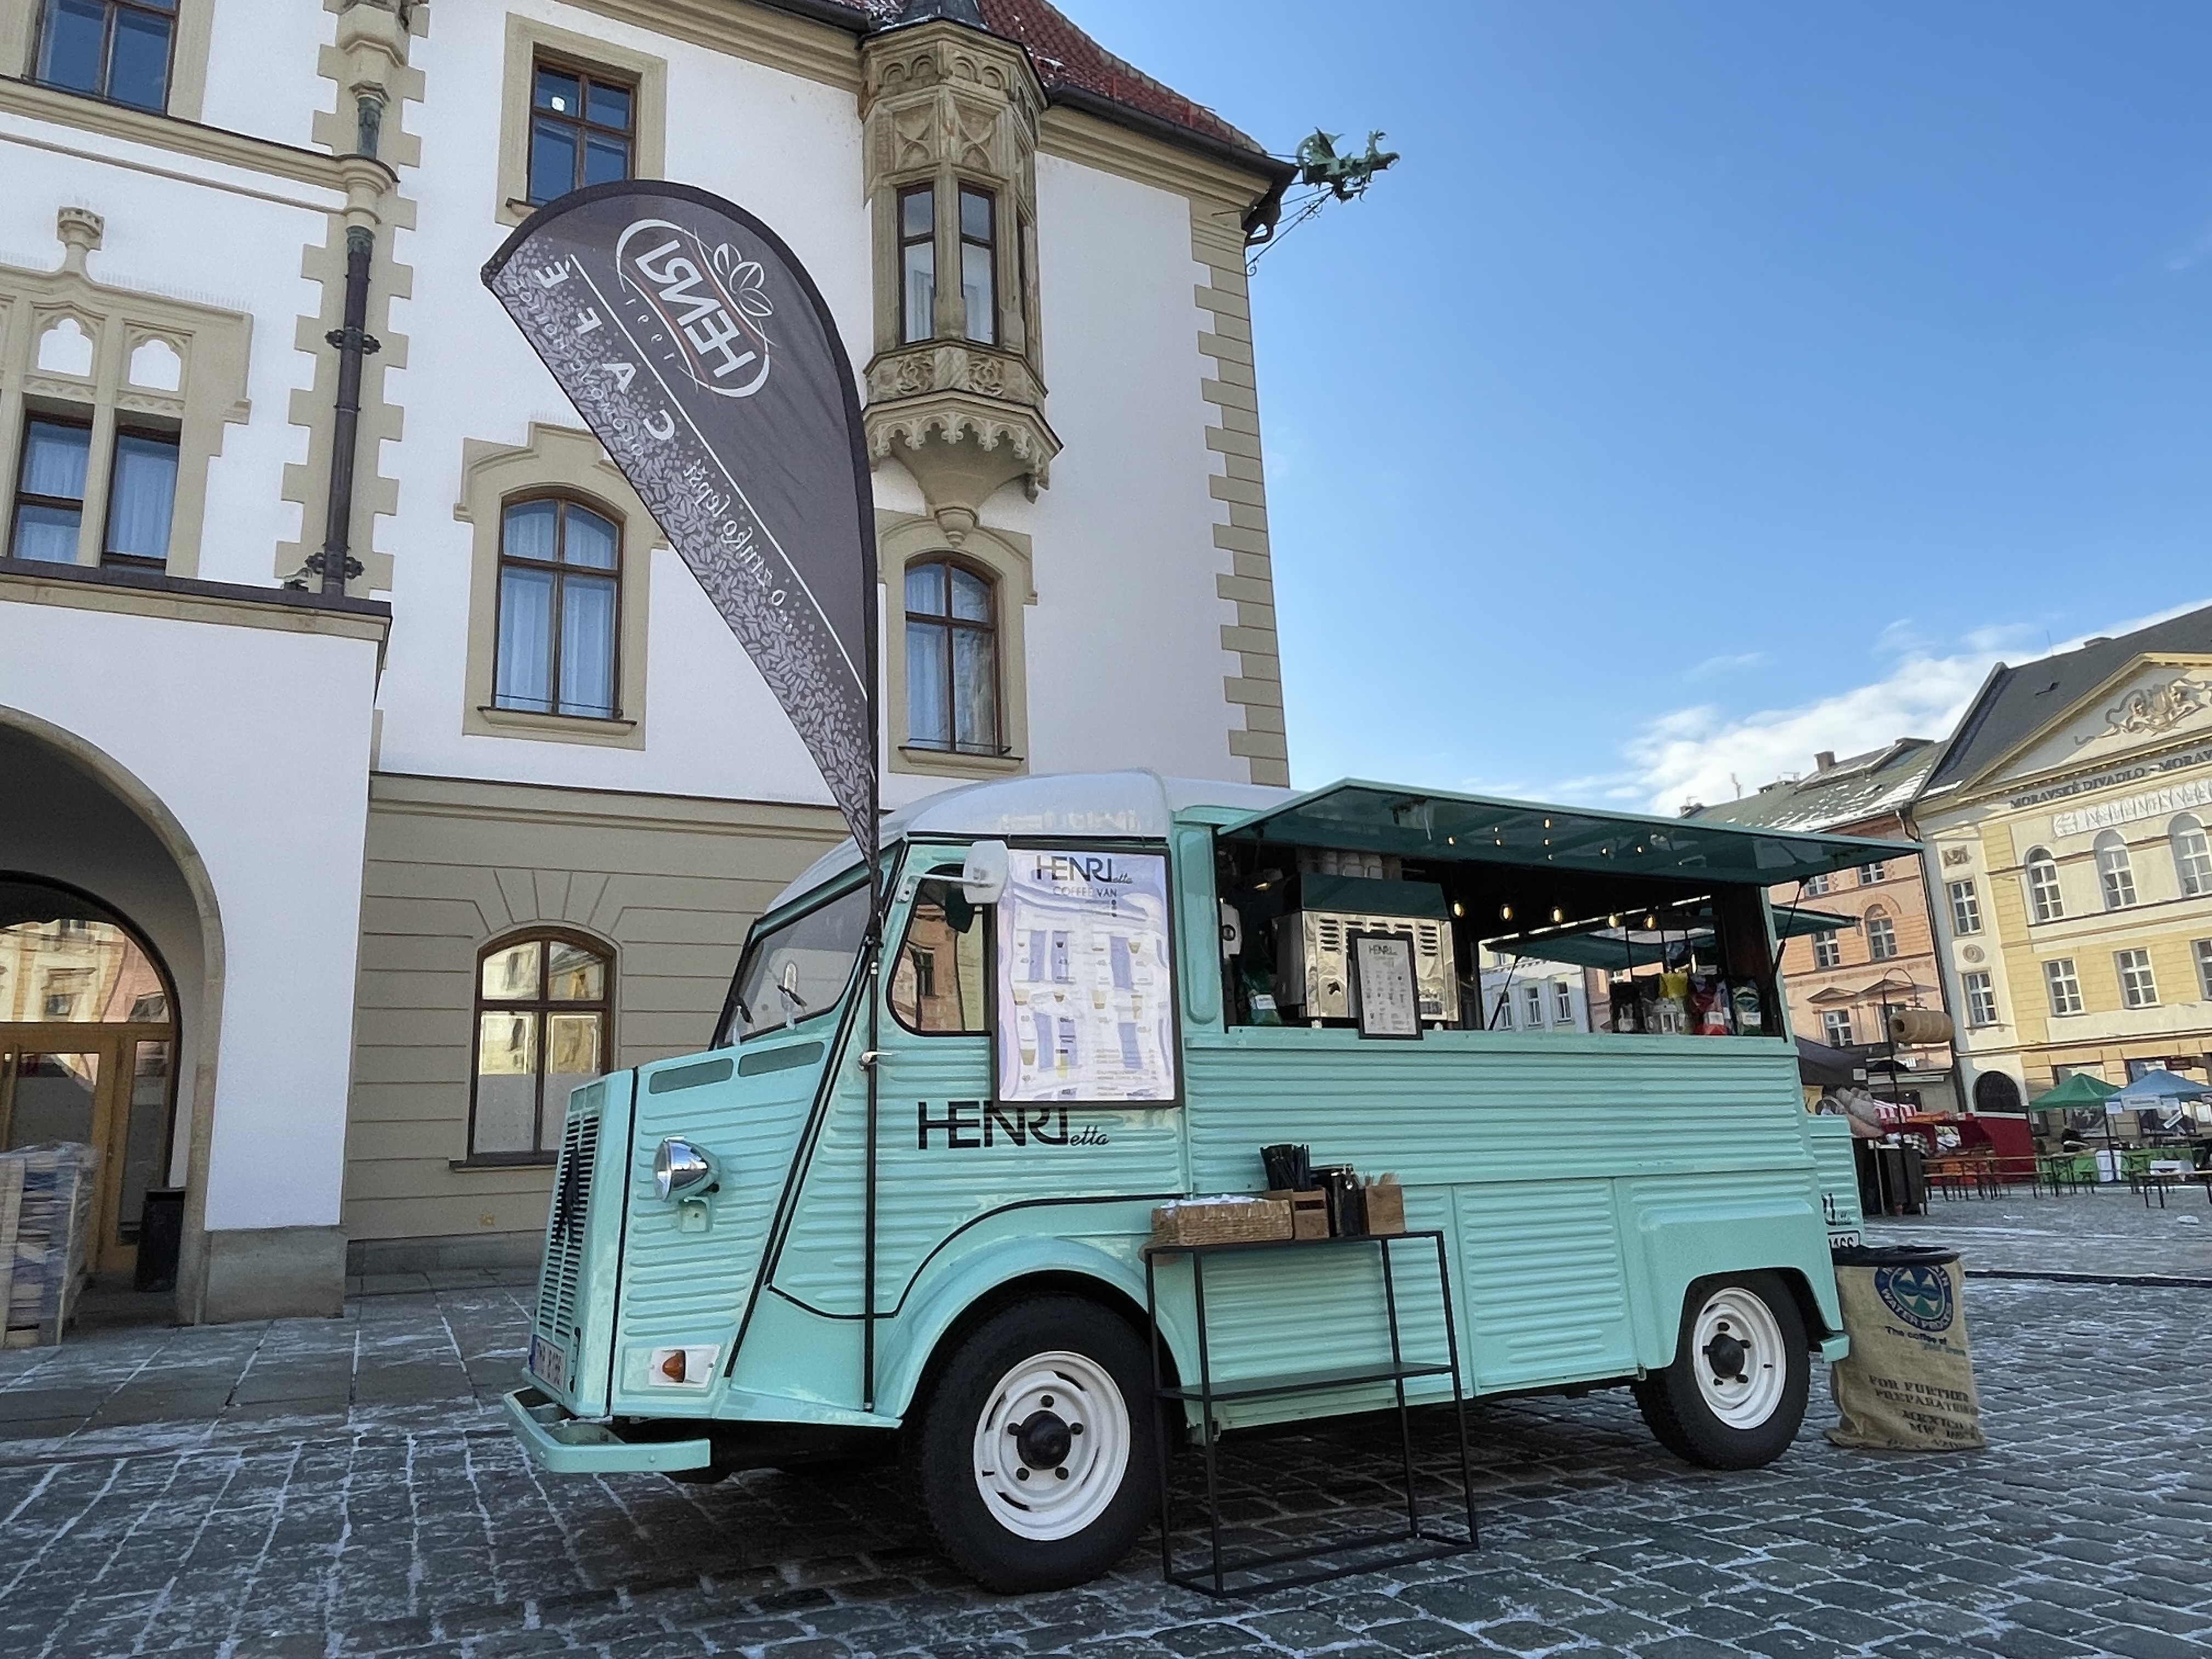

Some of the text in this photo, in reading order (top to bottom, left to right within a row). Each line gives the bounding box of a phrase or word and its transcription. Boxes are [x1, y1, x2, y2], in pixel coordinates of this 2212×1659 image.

[2083, 768, 2145, 790] DIVADLO
[1053, 885, 1117, 898] COFFEE VAN
[1869, 1375, 1970, 1402] FOR FURTHER
